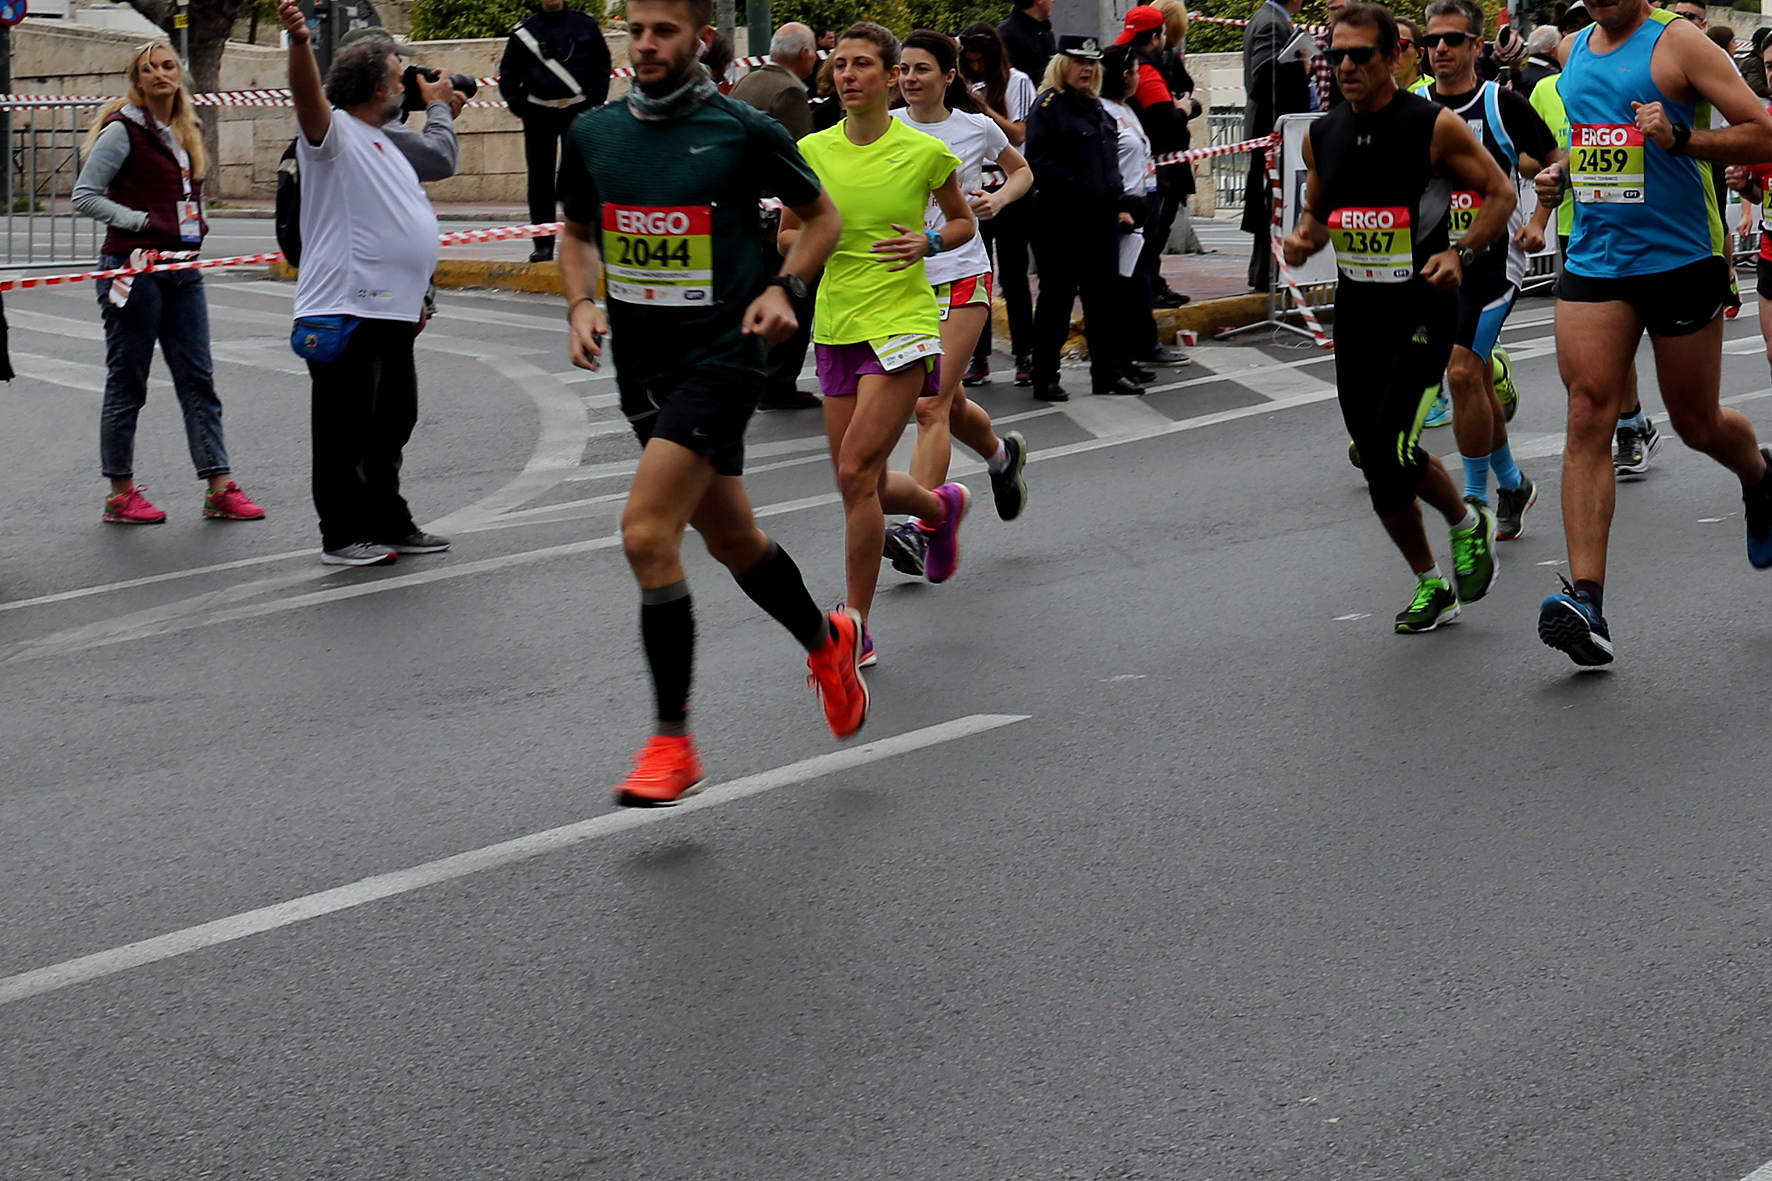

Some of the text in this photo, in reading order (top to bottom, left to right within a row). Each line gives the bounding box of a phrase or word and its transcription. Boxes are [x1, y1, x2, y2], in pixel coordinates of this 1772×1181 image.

[1581, 127, 1628, 146] ERGO
[1578, 148, 1628, 172] 2459
[615, 209, 691, 235] ERGO
[1341, 210, 1395, 229] ERGO
[616, 236, 691, 267] 2044
[1342, 231, 1396, 254] 2367
